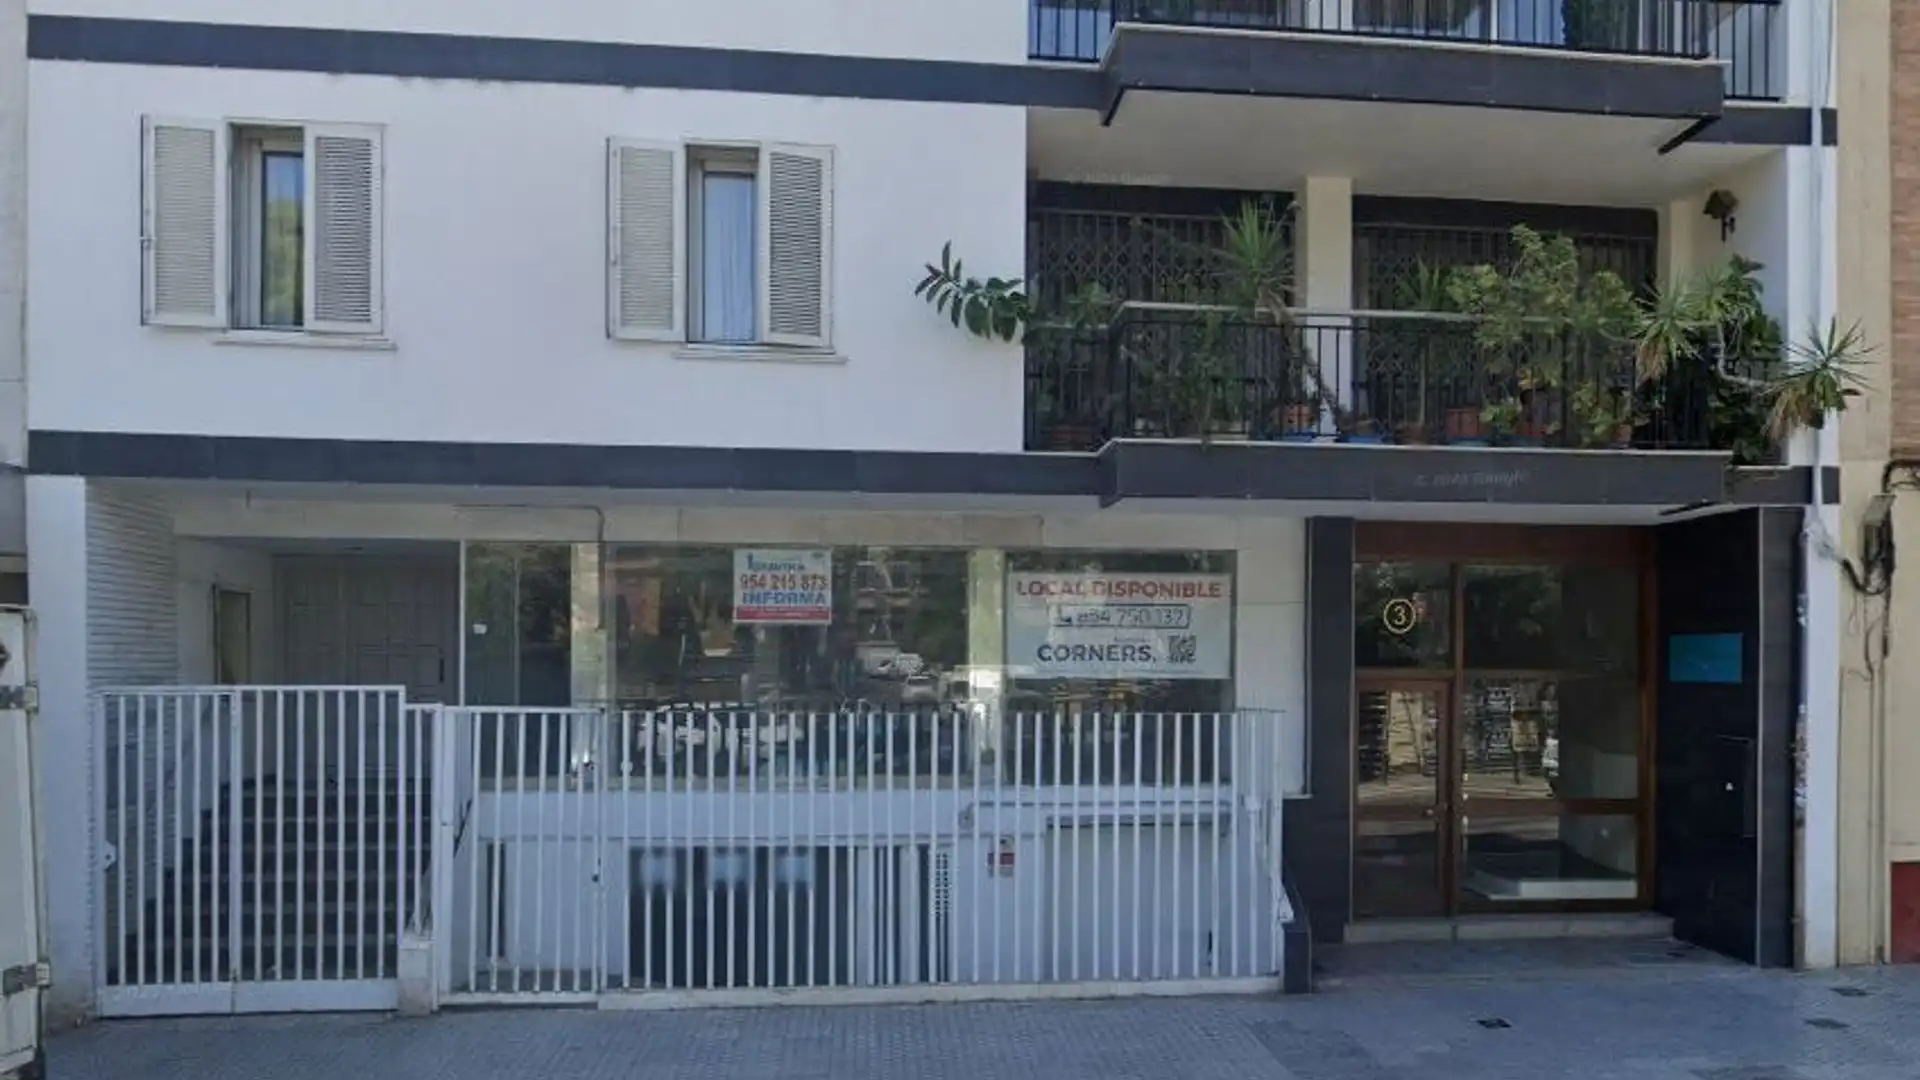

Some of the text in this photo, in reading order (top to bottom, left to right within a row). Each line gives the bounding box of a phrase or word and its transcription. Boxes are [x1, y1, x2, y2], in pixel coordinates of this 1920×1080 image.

[743, 591, 827, 605] INFORMA
[1017, 581, 1222, 598] LOCAL DISPONIBLE
[1394, 606, 1406, 625] 3
